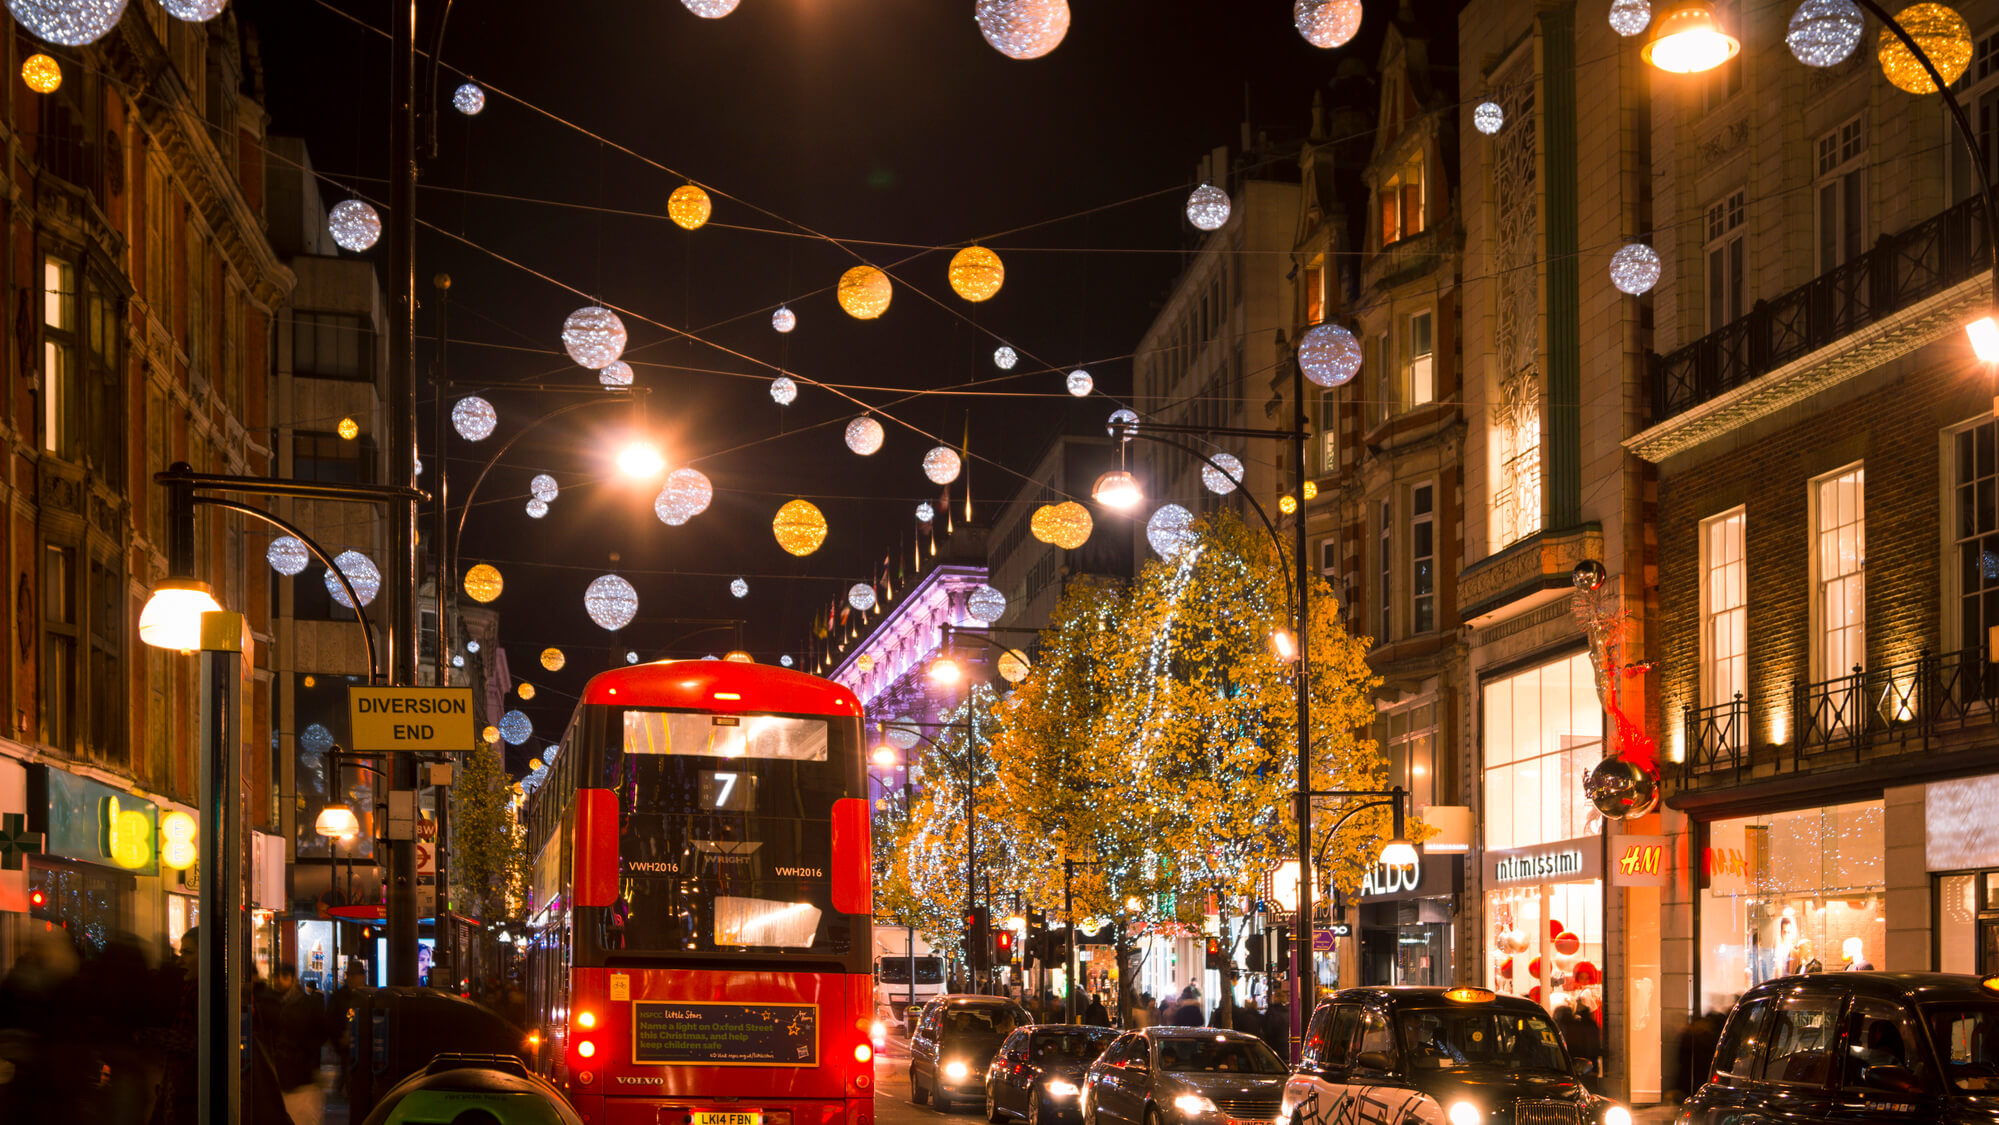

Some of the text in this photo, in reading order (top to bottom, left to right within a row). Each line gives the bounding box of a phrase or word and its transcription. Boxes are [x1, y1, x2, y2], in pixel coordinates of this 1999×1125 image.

[358, 697, 466, 714] DIVERSION
[393, 724, 434, 740] END
[714, 772, 738, 807] 7
[704, 855, 751, 864] WRIGHT
[1620, 845, 1663, 876] H&M
[629, 861, 679, 873] VWH2016
[775, 866, 823, 878] VWH2016
[1360, 860, 1420, 897] ALDO
[1458, 990, 1487, 1001] TAXI
[640, 1022, 667, 1031] Name
[675, 1023, 697, 1035] light
[712, 1023, 744, 1032] Oxford
[745, 1024, 773, 1032] Street
[640, 1031, 749, 1043] this Christmas, and help
[640, 1041, 722, 1050] keep children safe
[616, 1076, 664, 1085] VOLVO
[701, 1114, 751, 1125] LK14 FBN
